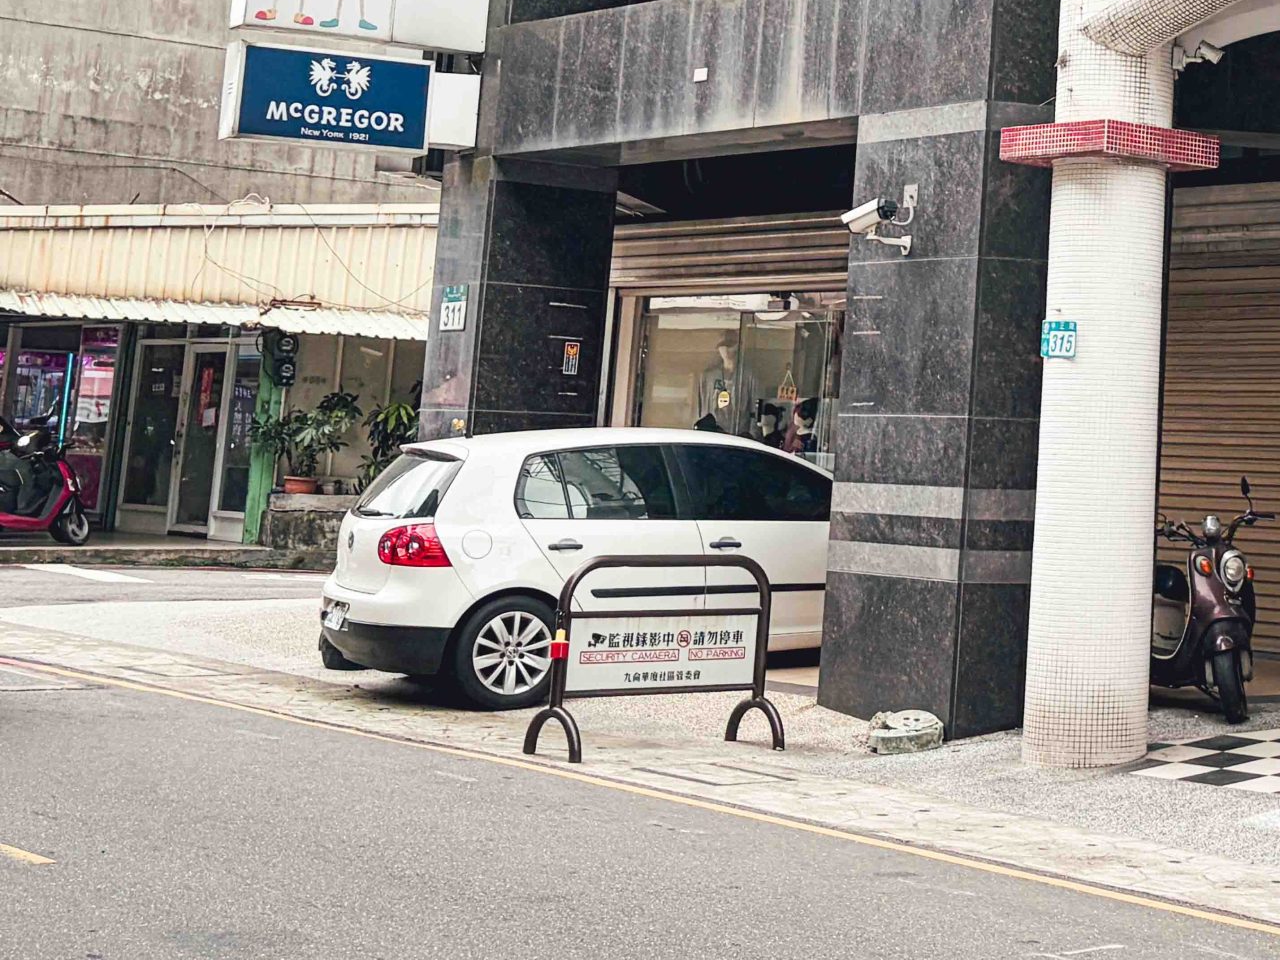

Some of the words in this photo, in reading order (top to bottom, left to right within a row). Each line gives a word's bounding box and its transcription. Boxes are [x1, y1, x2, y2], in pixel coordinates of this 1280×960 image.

[348, 132, 370, 142] 1921
[443, 304, 463, 327] 311
[1050, 333, 1074, 353] 315
[692, 629, 744, 646] 請勿停車
[582, 651, 628, 663] SECURITY
[632, 650, 678, 661] CAMAERA
[690, 649, 703, 659] NO
[706, 648, 744, 659] PARKING
